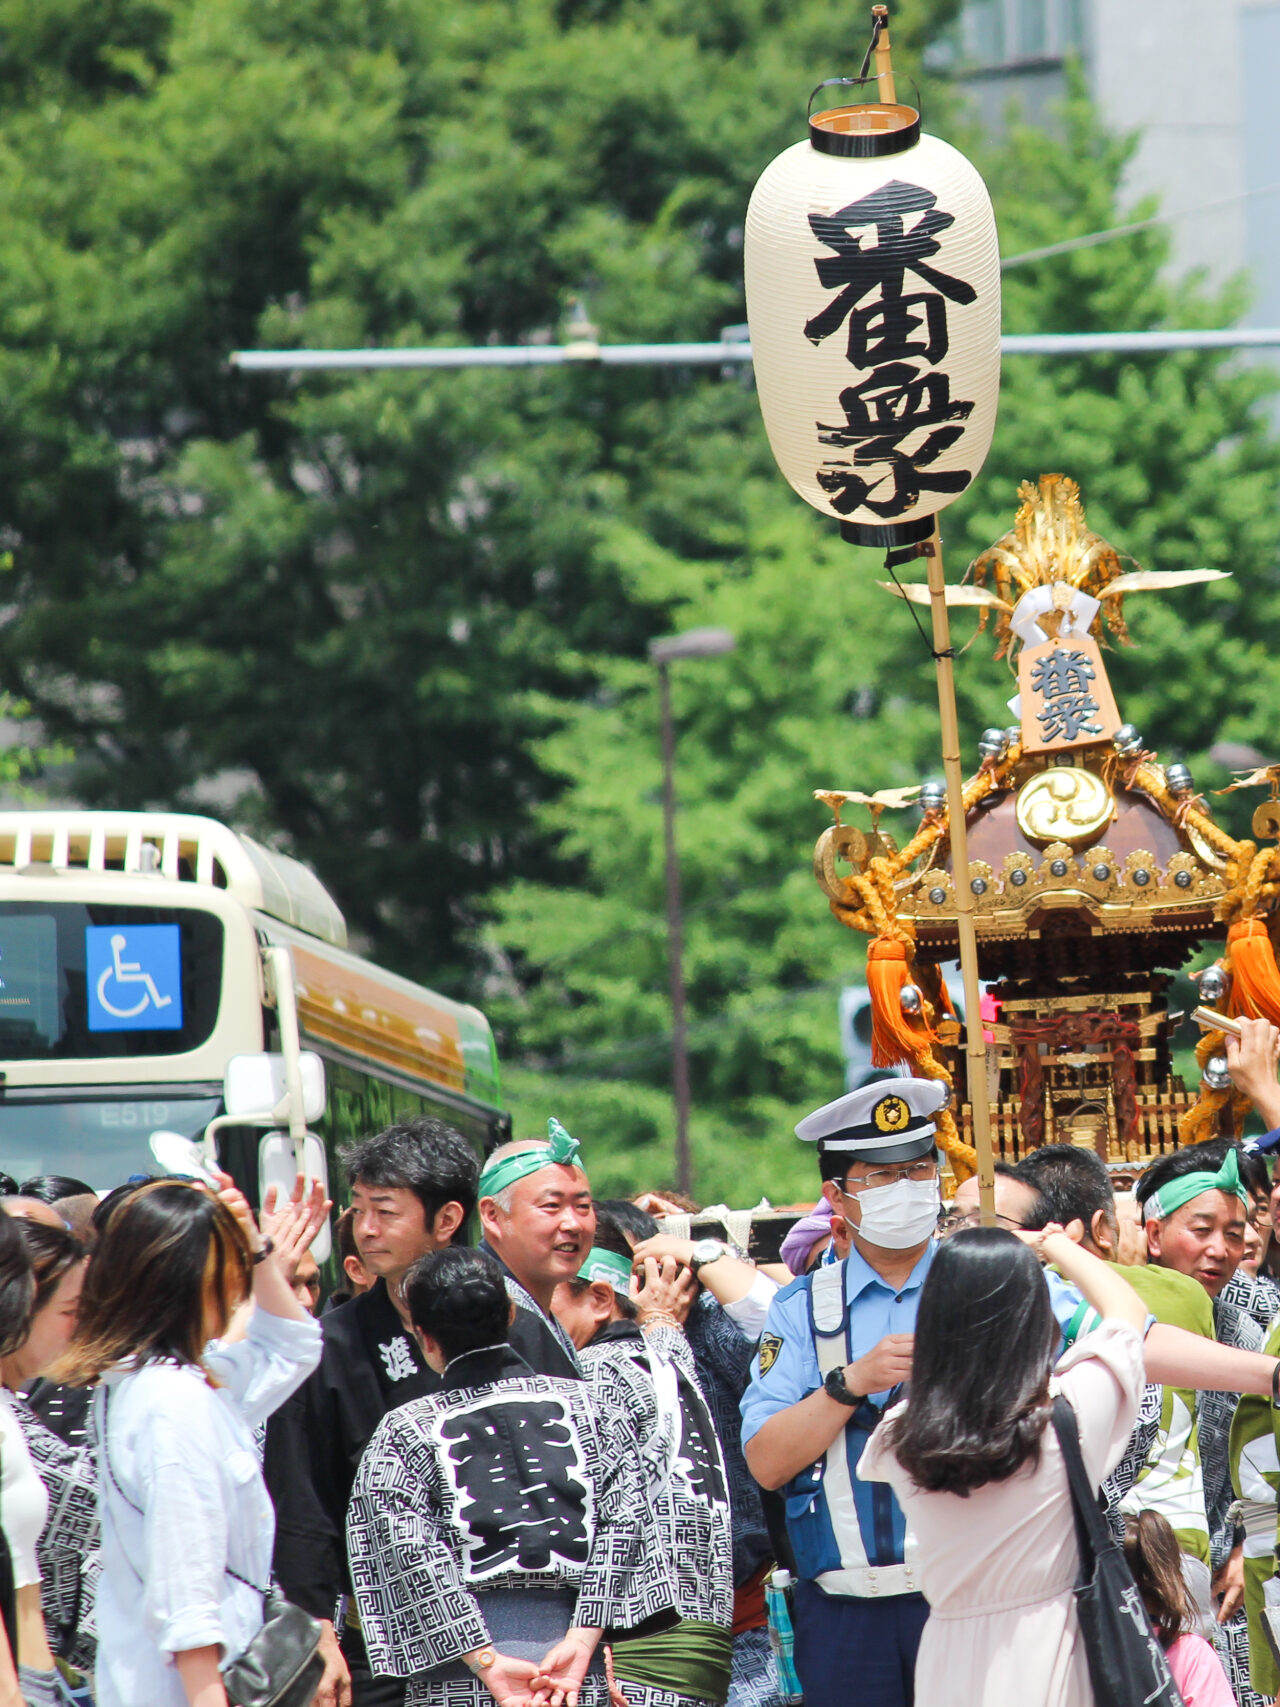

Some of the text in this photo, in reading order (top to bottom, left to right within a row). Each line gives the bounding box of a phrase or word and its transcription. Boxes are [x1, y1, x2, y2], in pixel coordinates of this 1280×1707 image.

[803, 179, 978, 518] 番衆
[1030, 648, 1104, 743] 番衆
[100, 1102, 169, 1126] E519
